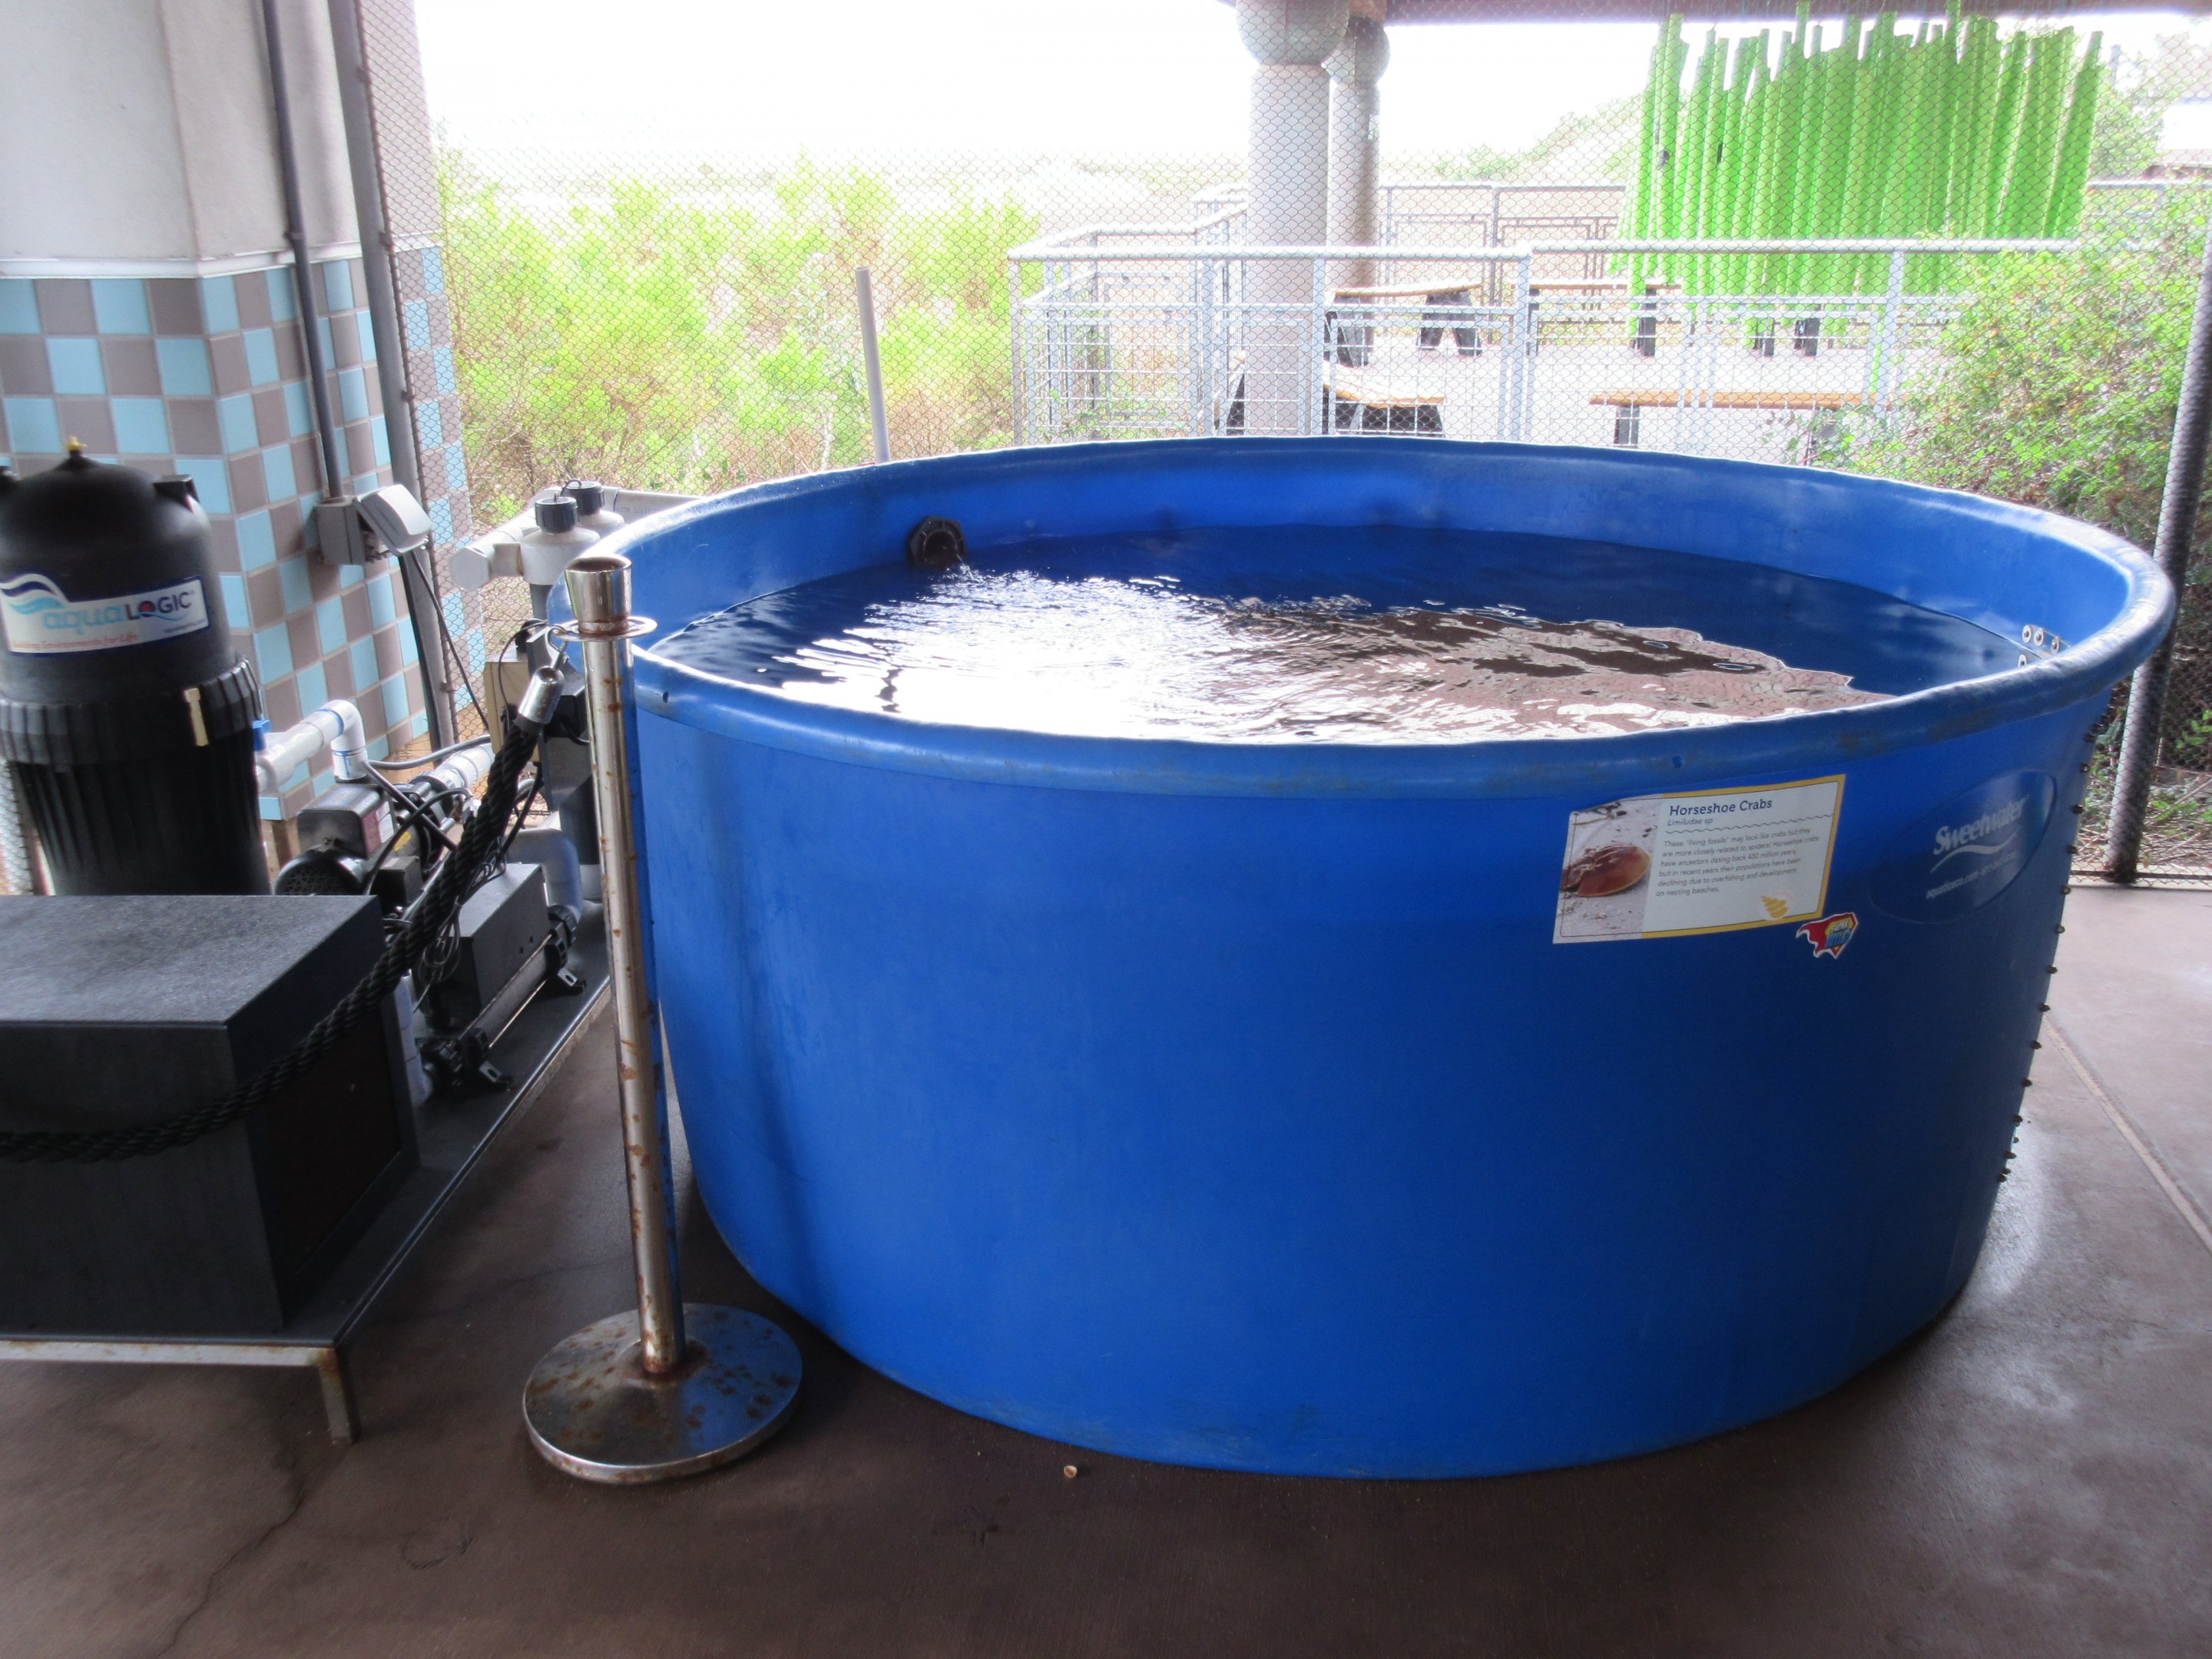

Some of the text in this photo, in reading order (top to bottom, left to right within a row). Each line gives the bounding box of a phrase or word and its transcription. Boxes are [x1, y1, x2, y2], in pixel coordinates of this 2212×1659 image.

[1669, 799, 1773, 816] Horseshoe Crabs
[1932, 794, 2030, 855] Sweetwater
[1694, 847, 1715, 856] closely
[1773, 838, 1803, 846] Horseshoe
[1677, 858, 1709, 866] ancestors
[1710, 856, 1730, 864] dating
[1760, 850, 1780, 859] million
[1657, 879, 1687, 887] declining
[1711, 873, 1745, 883] overfishing
[1759, 867, 1797, 878] development
[1659, 869, 1671, 877] but
[1680, 867, 1700, 876] recent
[1702, 866, 1720, 875] years
[1736, 861, 1770, 871] populations
[1666, 888, 1690, 897] nesting
